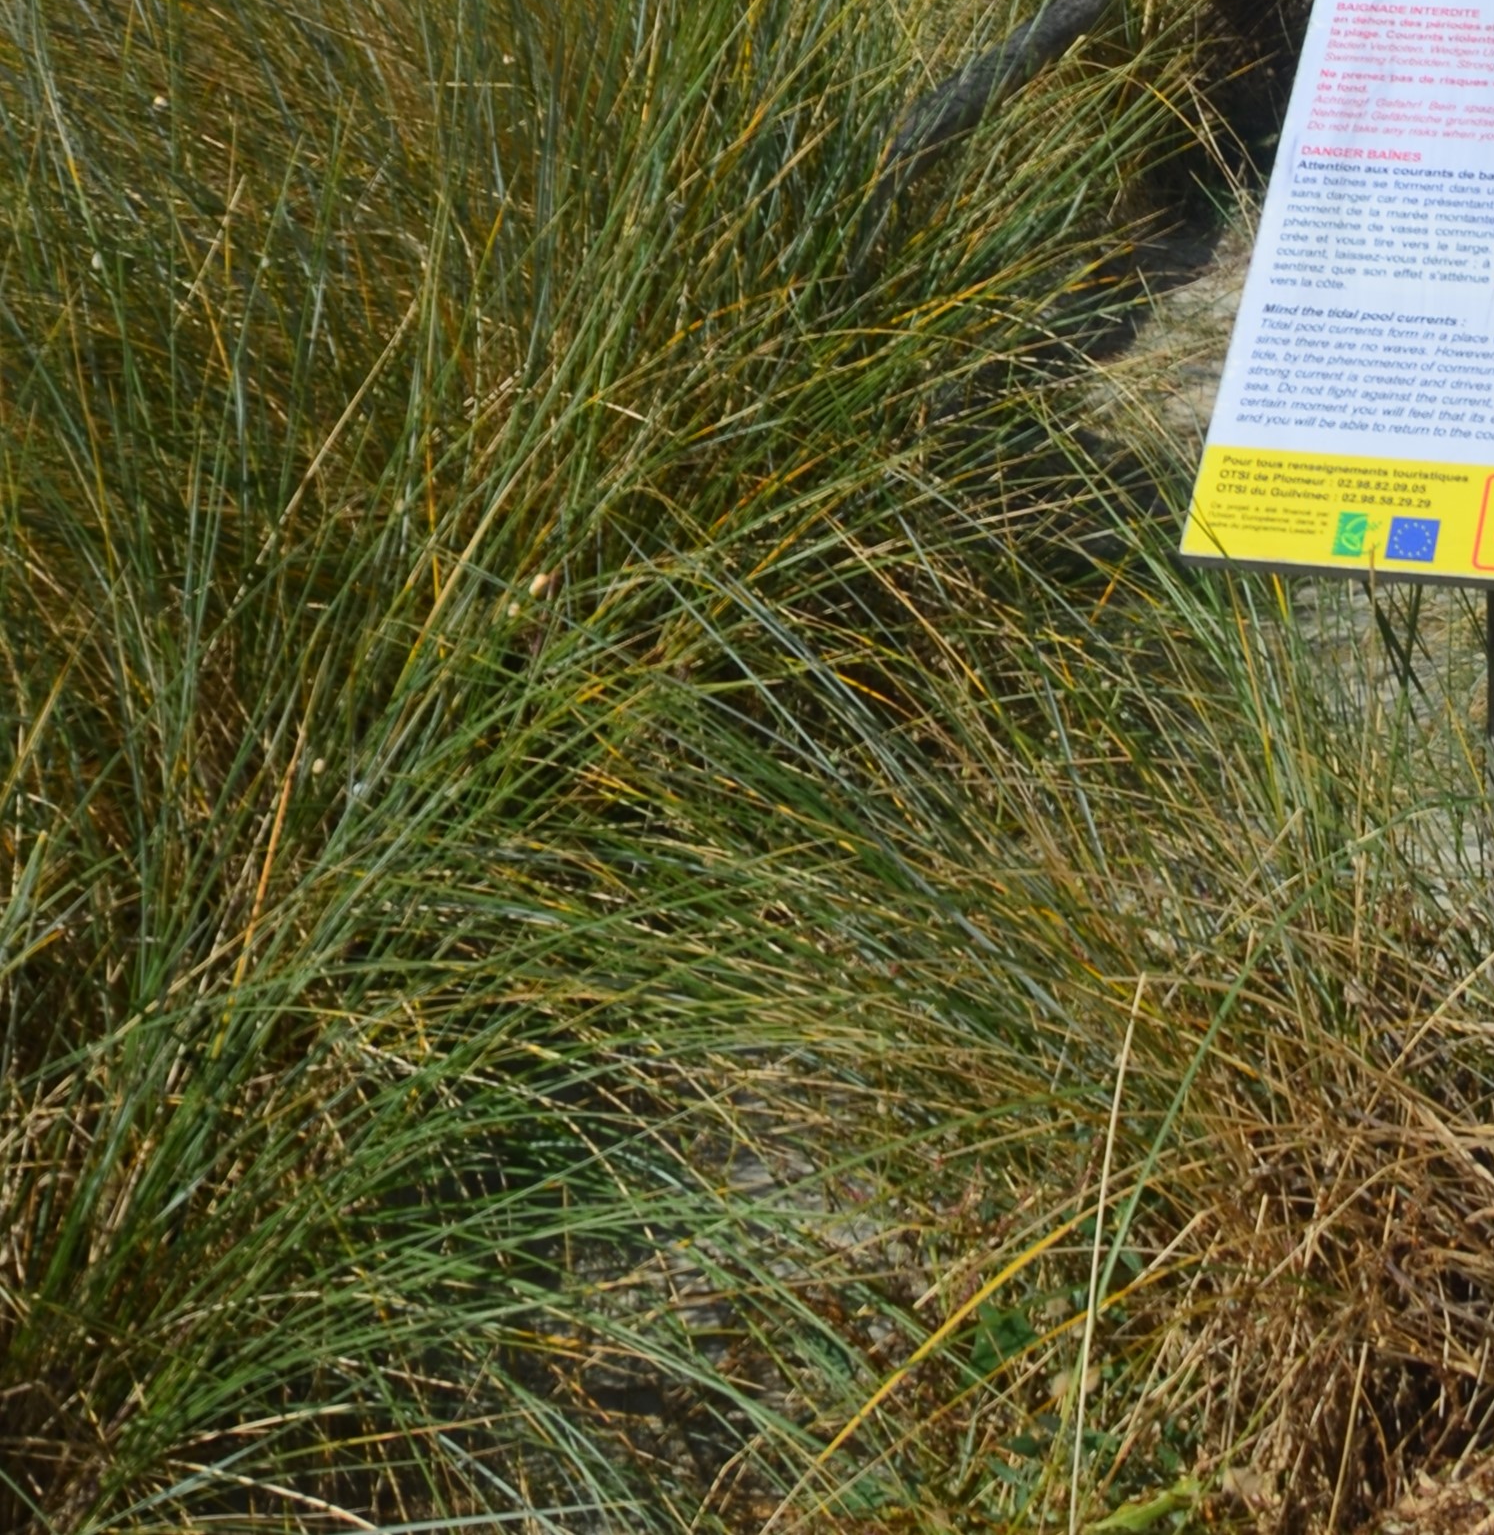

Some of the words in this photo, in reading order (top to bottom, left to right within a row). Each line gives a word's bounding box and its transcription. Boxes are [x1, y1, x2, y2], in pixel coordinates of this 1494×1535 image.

[1336, 2, 1405, 14] BAIGNADE
[1409, 6, 1479, 18] INTERDITE
[1301, 145, 1363, 158] DANGER
[1367, 149, 1421, 161] BAÏNES
[1297, 160, 1361, 172] Attention
[1364, 166, 1388, 174] aux
[1392, 167, 1454, 178] courants
[1457, 170, 1475, 179] de
[1263, 303, 1299, 315] Mind
[1301, 306, 1324, 317] the
[1327, 308, 1359, 319] tidal
[1360, 312, 1395, 322] pool
[1396, 314, 1457, 326] currents
[1222, 455, 1253, 466] Pour
[1256, 458, 1283, 469] tous
[1287, 462, 1388, 477] renseignements
[1392, 469, 1469, 483] touristiques
